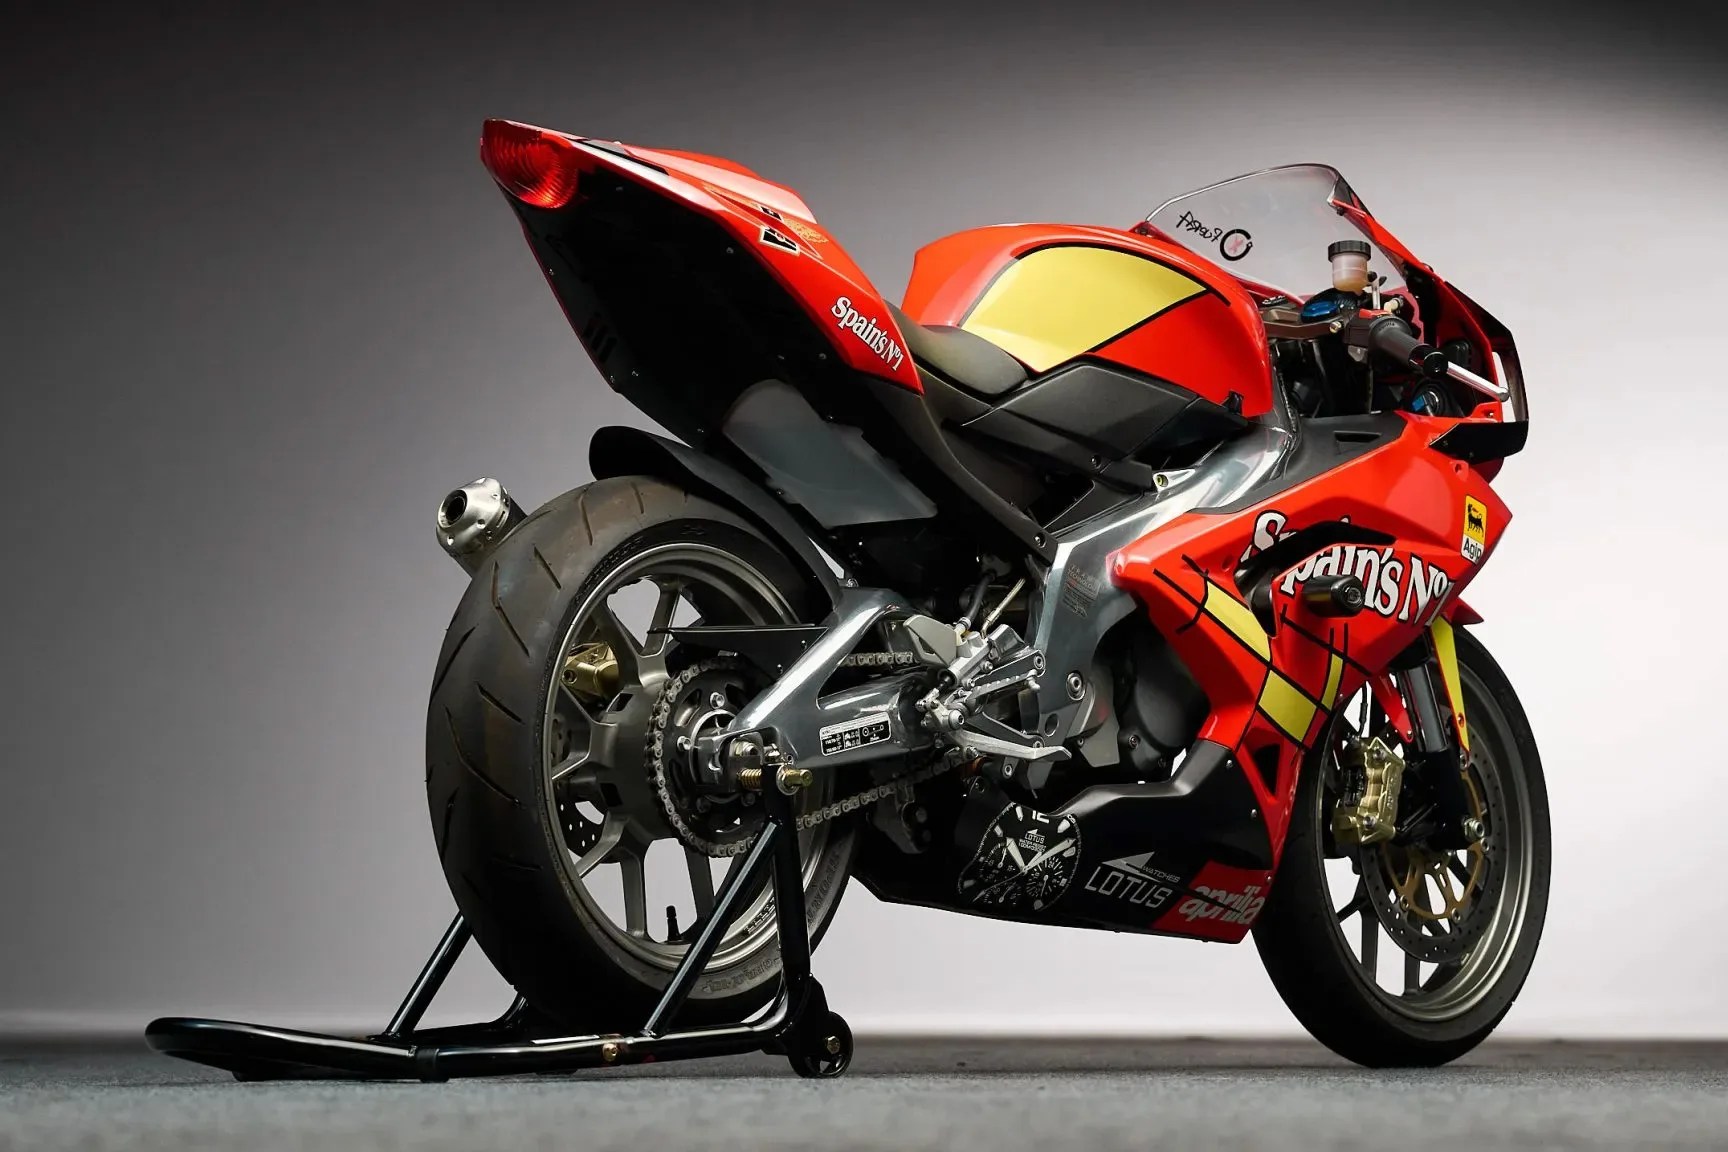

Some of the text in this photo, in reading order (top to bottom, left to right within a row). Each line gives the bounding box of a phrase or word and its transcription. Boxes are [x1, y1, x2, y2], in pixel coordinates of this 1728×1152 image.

[831, 296, 888, 354] Spain's
[1463, 537, 1482, 563] Agip
[1025, 833, 1045, 844] LOTUS
[1084, 866, 1173, 908] LOTUS
[1142, 866, 1180, 883] WATCHES
[1179, 885, 1266, 925] aprilia
